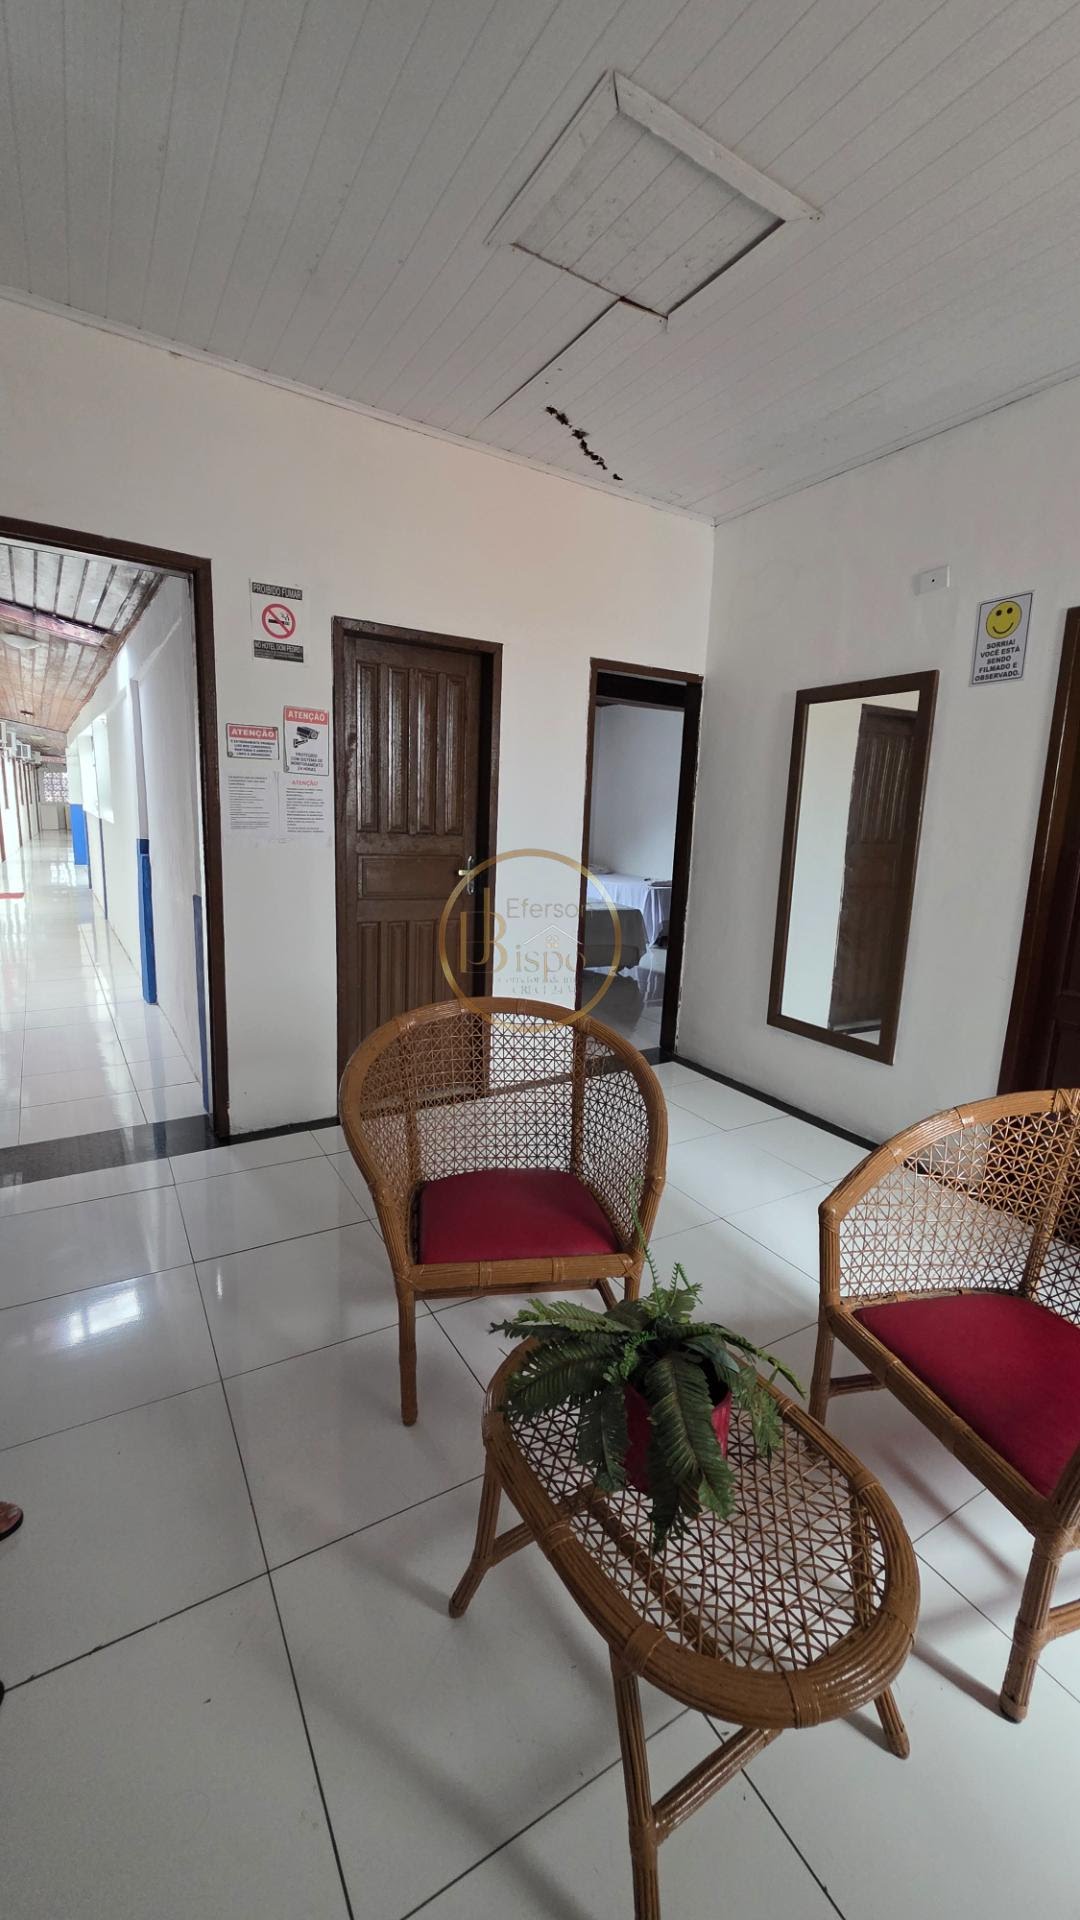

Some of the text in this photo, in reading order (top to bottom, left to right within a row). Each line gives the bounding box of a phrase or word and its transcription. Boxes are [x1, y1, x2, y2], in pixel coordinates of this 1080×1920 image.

[253, 583, 302, 600] PROIBIDO FUMAR
[262, 642, 275, 650] HOTEL
[987, 639, 1016, 650] SORRIA!
[981, 645, 1020, 658] VOCÊ ESTÁ
[987, 655, 1011, 665] SENDO
[979, 663, 1010, 673] FILMADO
[975, 670, 1019, 681] OBSERVADO.
[288, 709, 326, 722] ATENÇÃO
[231, 728, 275, 738] ATENÇÃO
